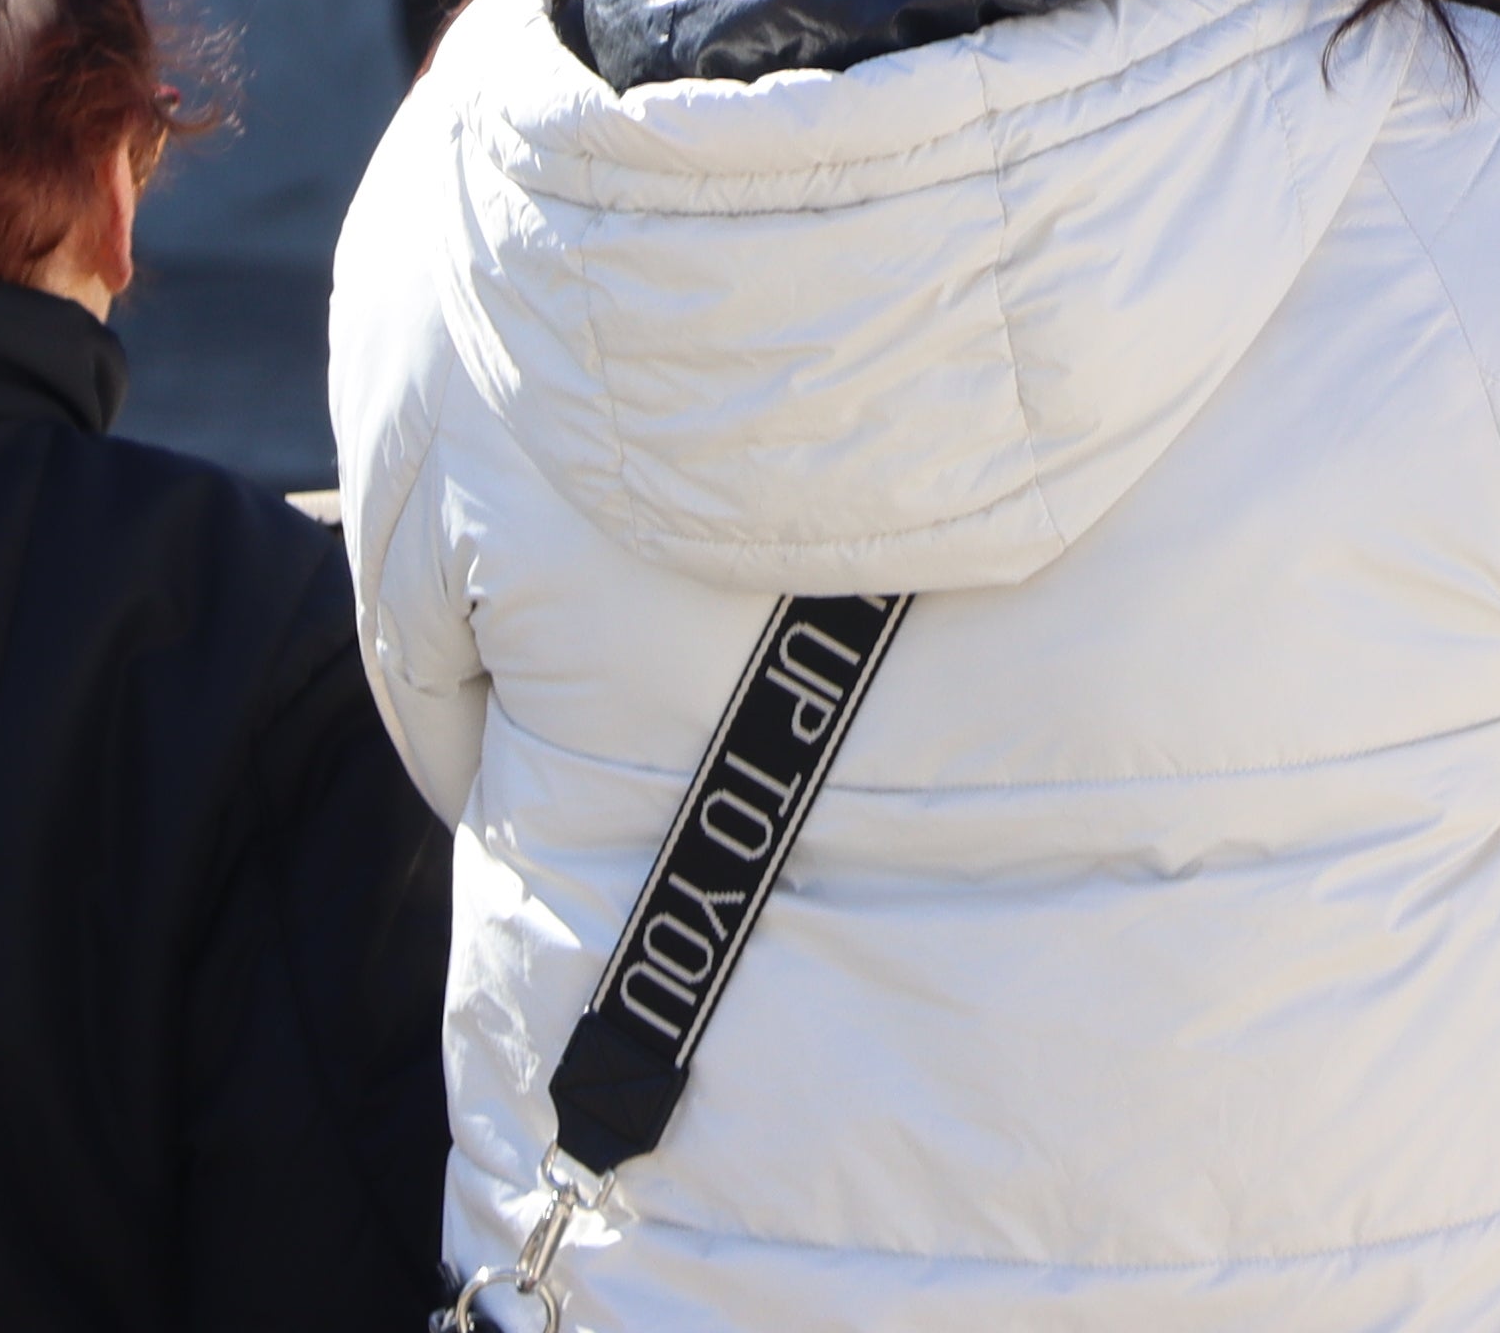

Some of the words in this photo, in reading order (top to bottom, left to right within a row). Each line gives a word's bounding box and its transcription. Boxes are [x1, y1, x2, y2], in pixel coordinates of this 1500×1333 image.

[764, 620, 862, 746] UP
[699, 749, 803, 863] TO
[618, 871, 747, 1042] YOU
